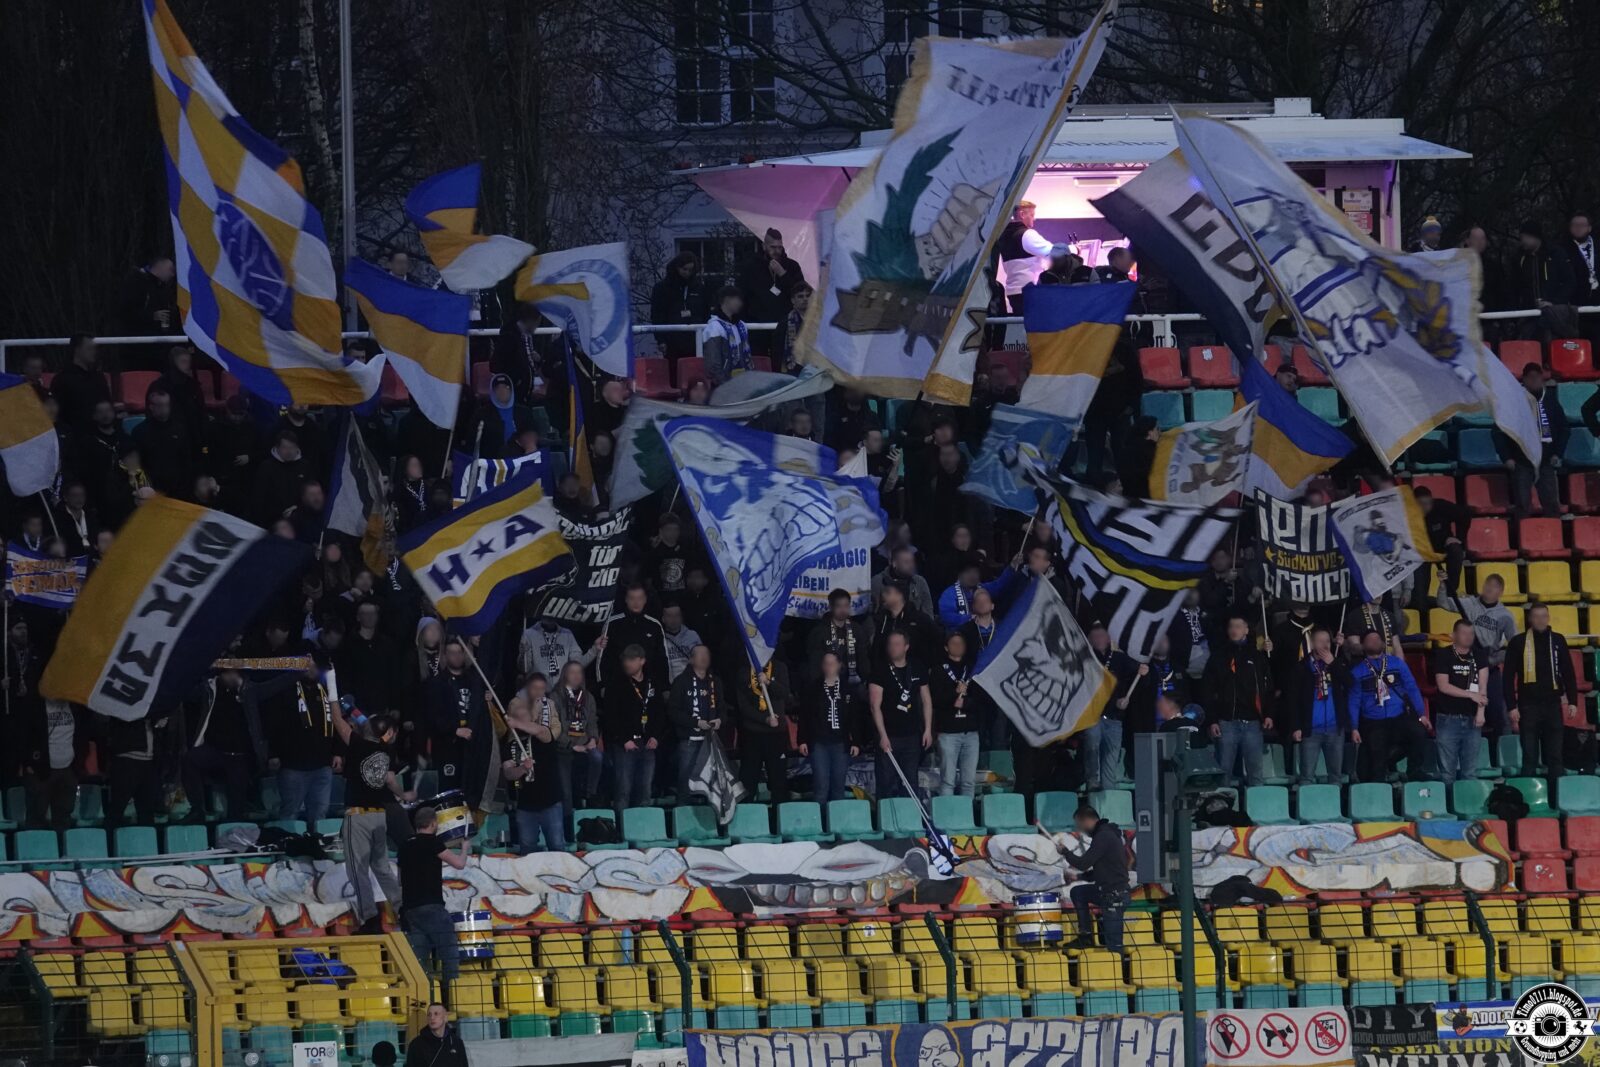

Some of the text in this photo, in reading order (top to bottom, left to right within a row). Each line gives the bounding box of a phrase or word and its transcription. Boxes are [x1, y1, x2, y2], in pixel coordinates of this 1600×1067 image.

[588, 544, 623, 567] für
[1277, 549, 1337, 571] Südkurve
[304, 1047, 326, 1057] TOR
